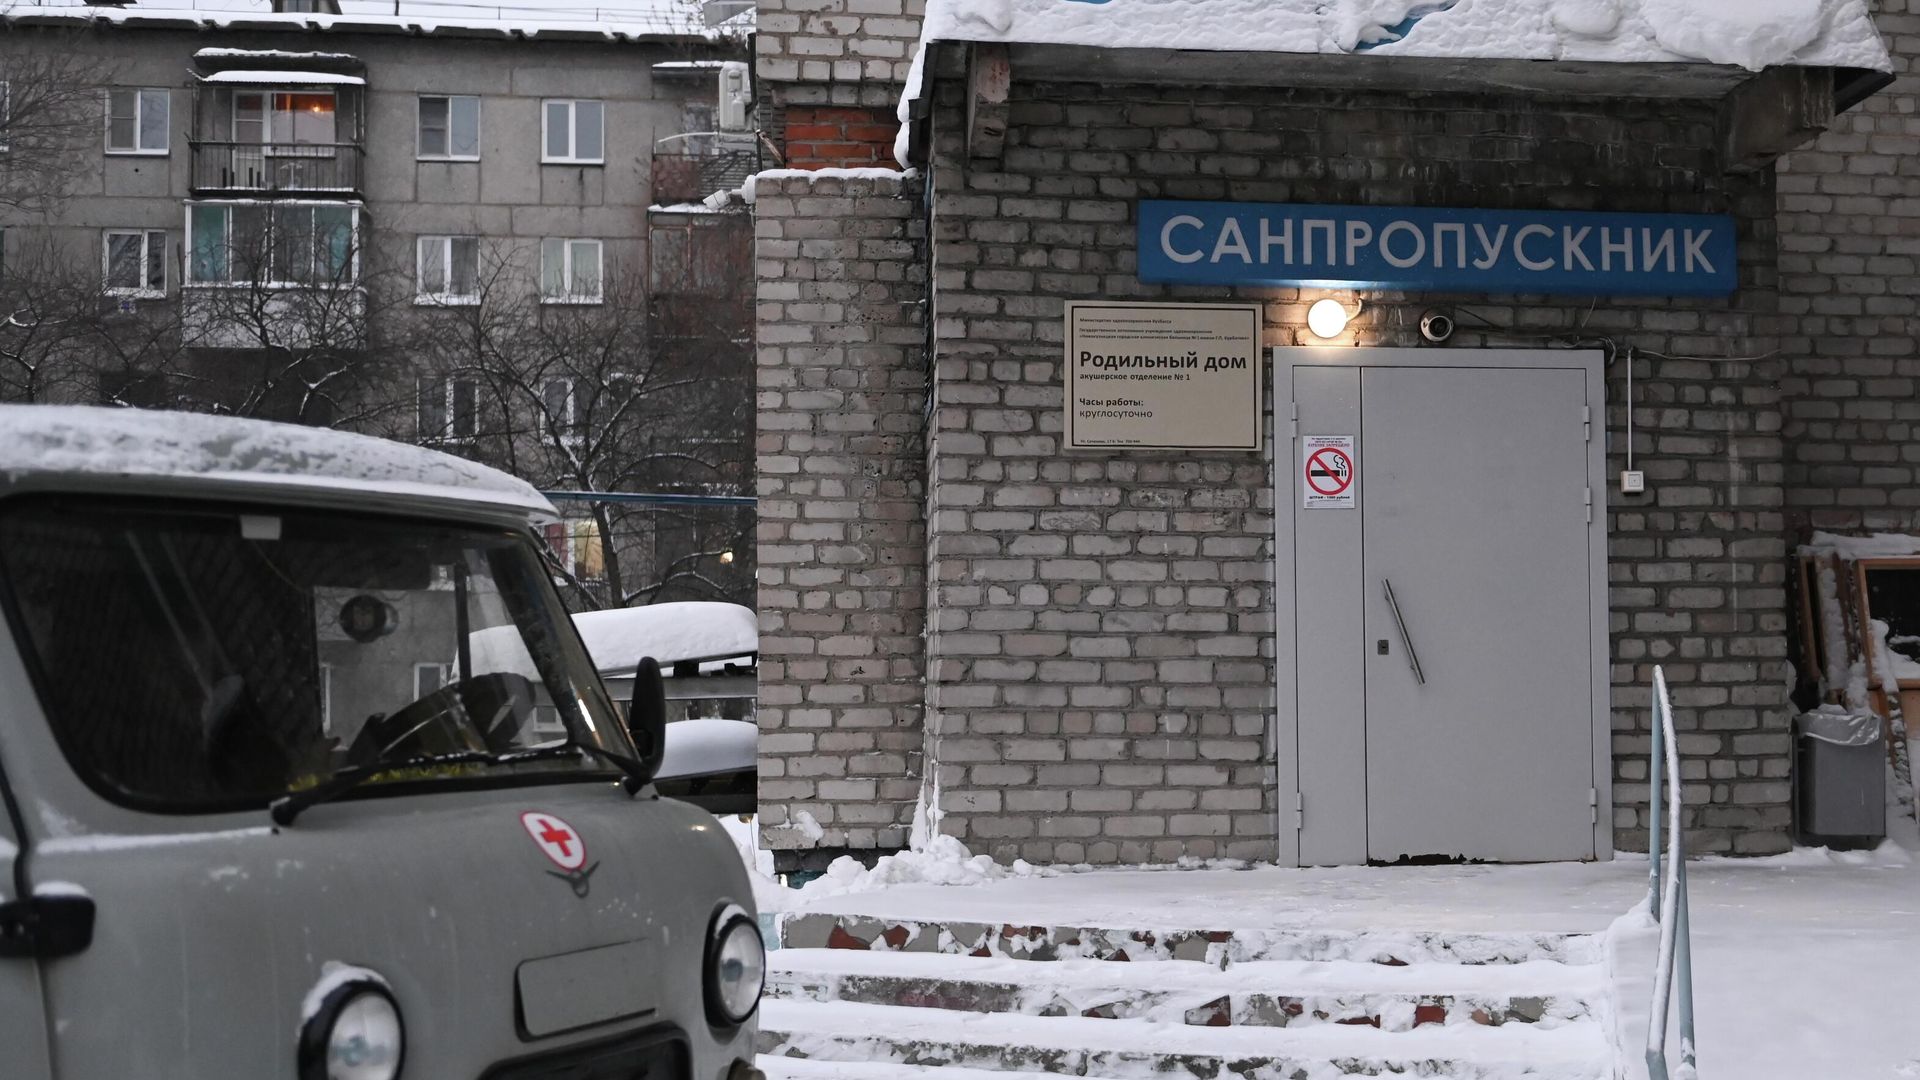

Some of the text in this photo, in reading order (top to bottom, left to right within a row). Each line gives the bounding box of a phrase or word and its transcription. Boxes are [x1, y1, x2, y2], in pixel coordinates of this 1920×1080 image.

[1160, 214, 1716, 274] САНПРОПУСКНИК
[1080, 351, 1247, 372] Родильный дом
[1079, 373, 1128, 381] акушерское
[1079, 397, 1144, 407] Часы работы:
[1079, 410, 1153, 419] круглосуточно
